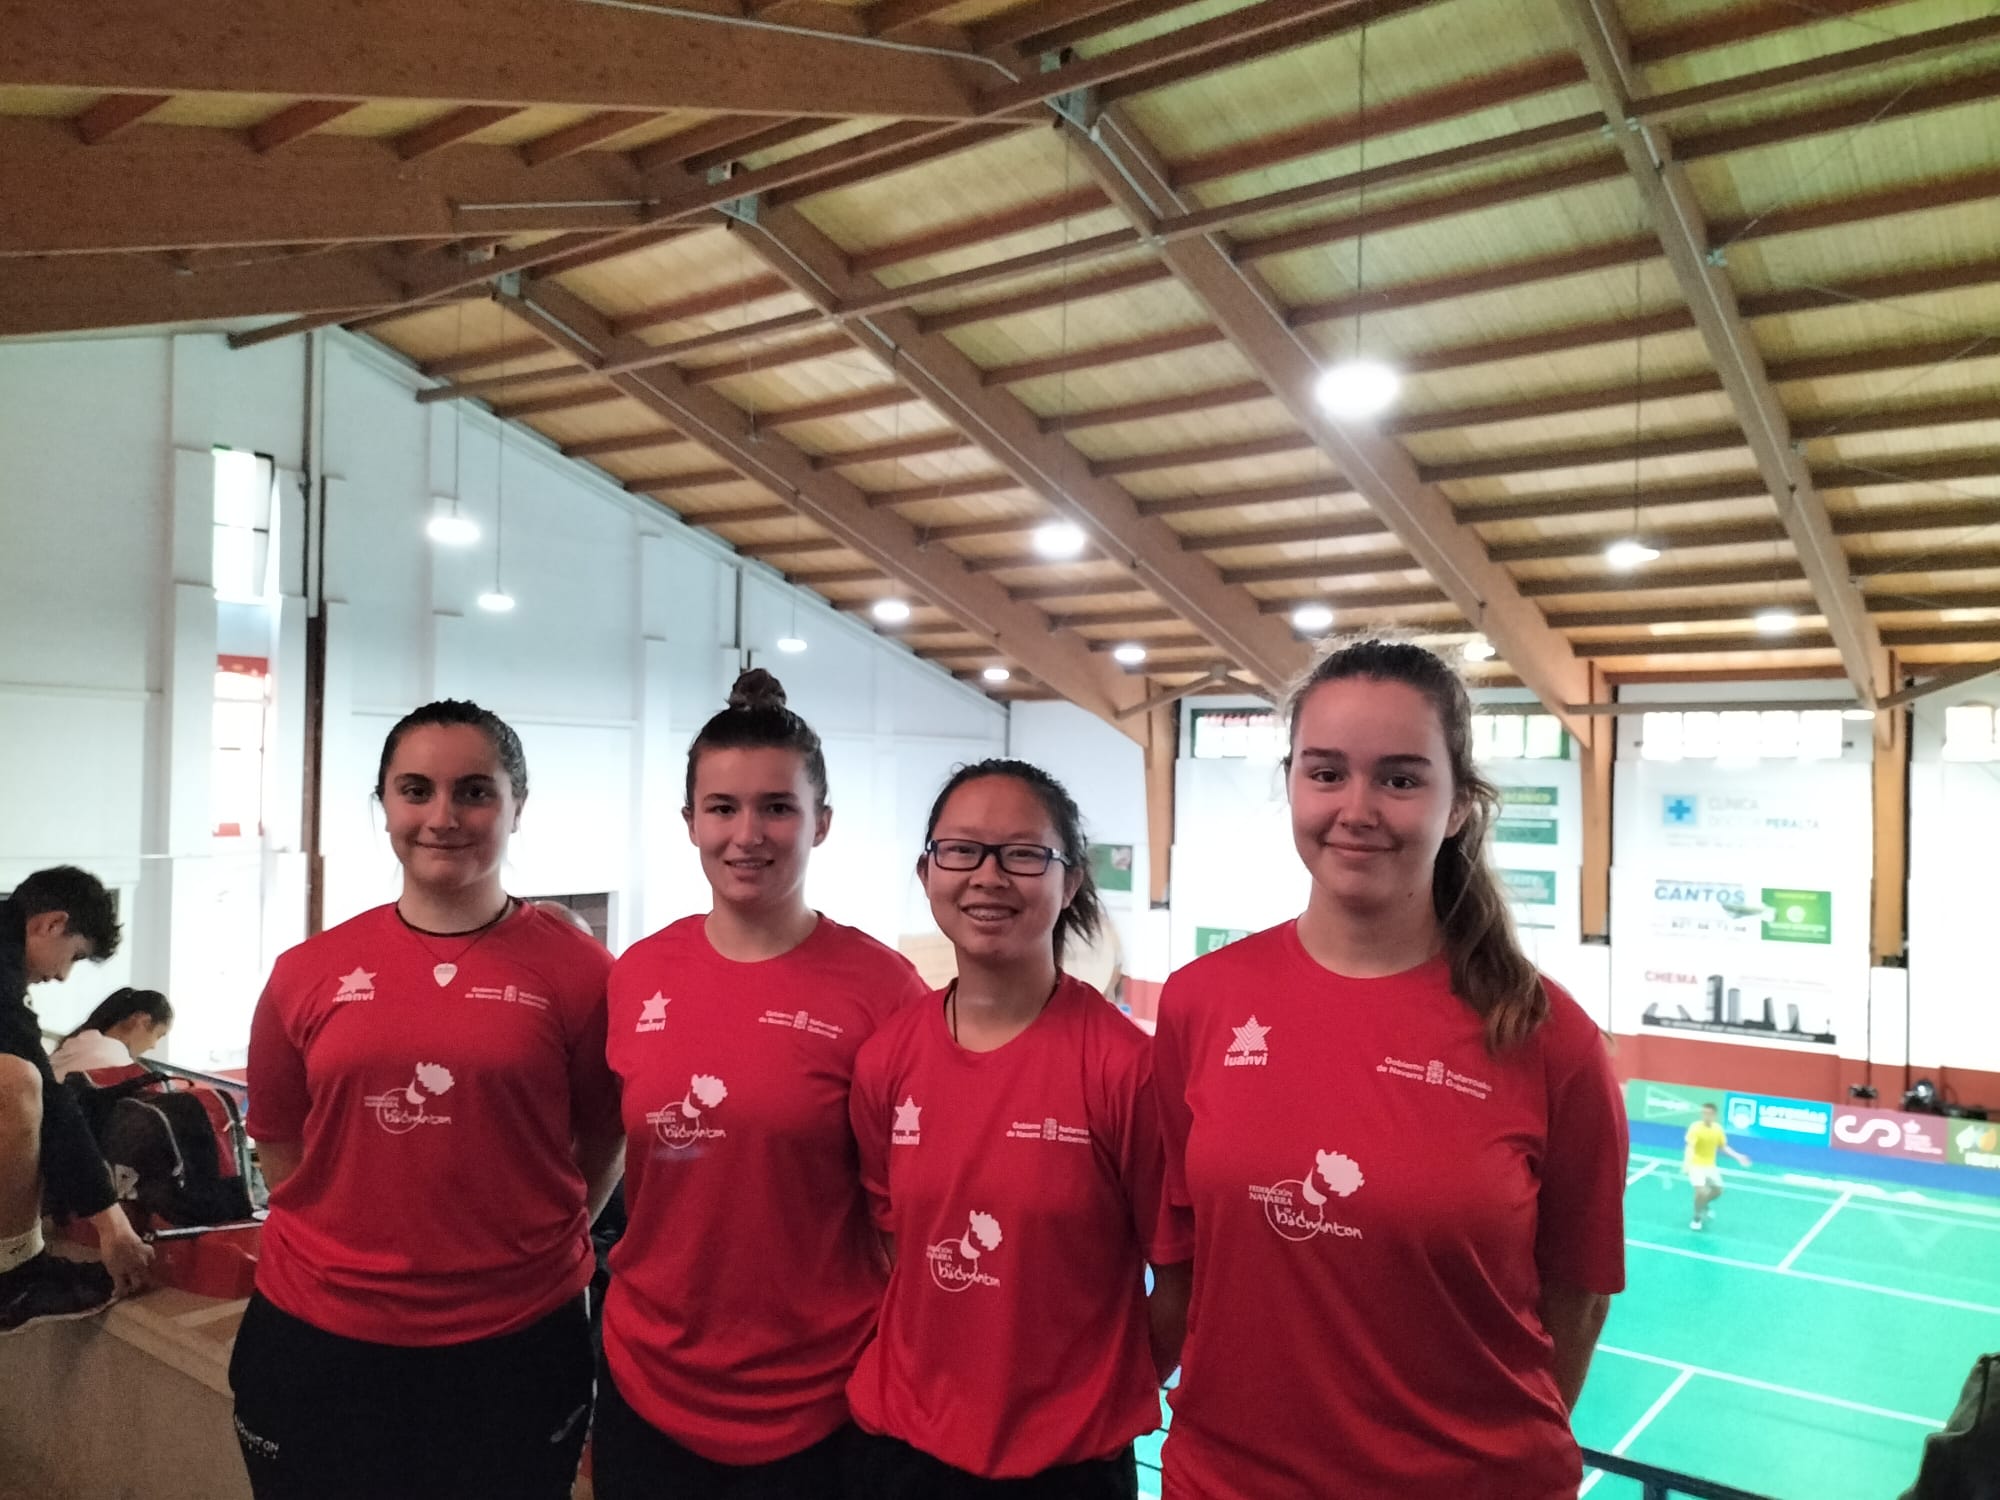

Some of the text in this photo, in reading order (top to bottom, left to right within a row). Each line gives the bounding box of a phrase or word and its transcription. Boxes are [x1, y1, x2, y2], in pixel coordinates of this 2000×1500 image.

[1654, 884, 1746, 906] CANTOS
[1644, 969, 1699, 985] CHEMA
[1224, 1052, 1269, 1067] luanvi
